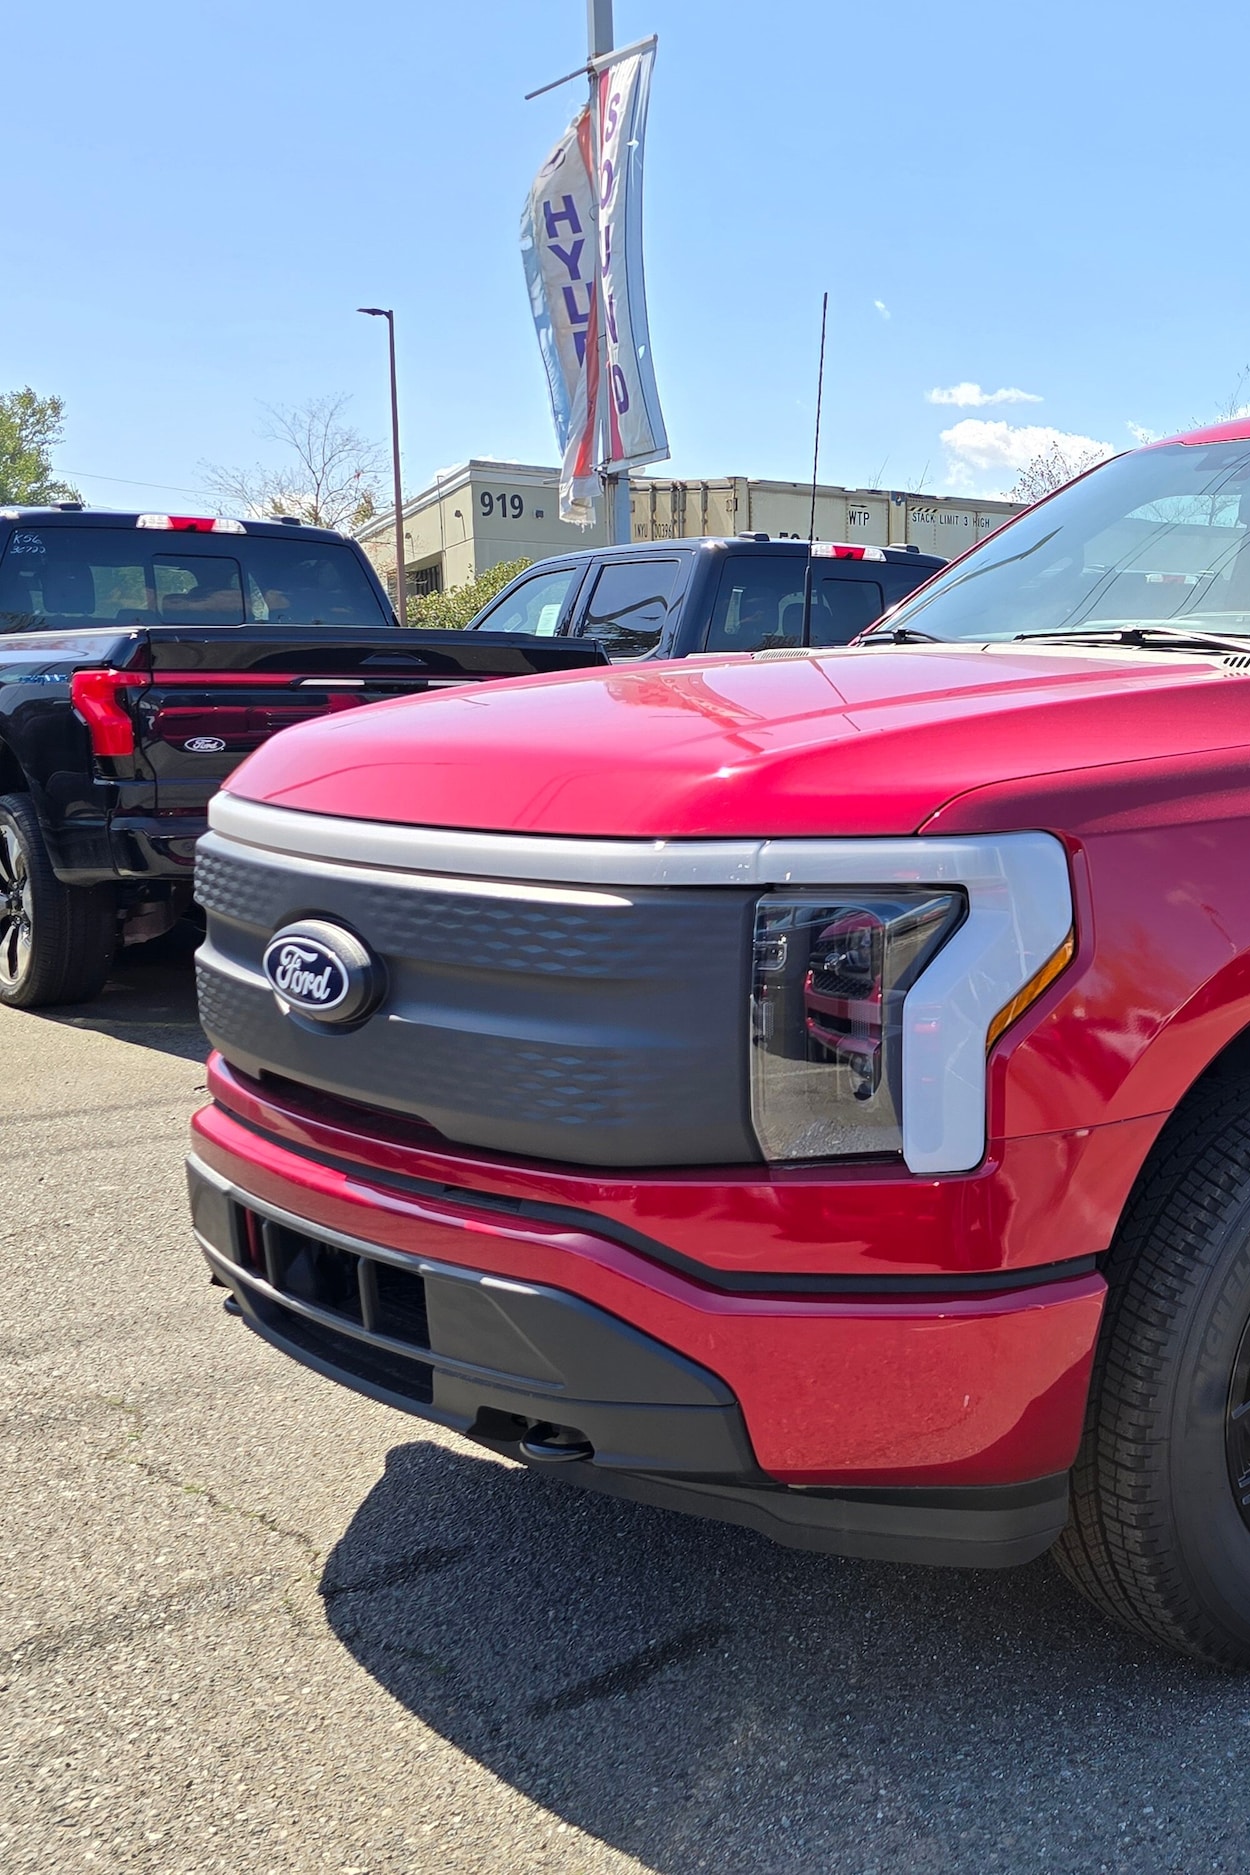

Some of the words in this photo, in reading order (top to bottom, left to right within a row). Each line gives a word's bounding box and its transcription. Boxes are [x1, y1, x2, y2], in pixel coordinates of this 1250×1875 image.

[480, 491, 524, 519] 919
[848, 510, 870, 526] WTP
[911, 511, 935, 524] STACK
[939, 514, 960, 526] LIMIT
[963, 516, 969, 527] 3
[973, 517, 990, 529] HIGH
[274, 943, 334, 1002] Ford
